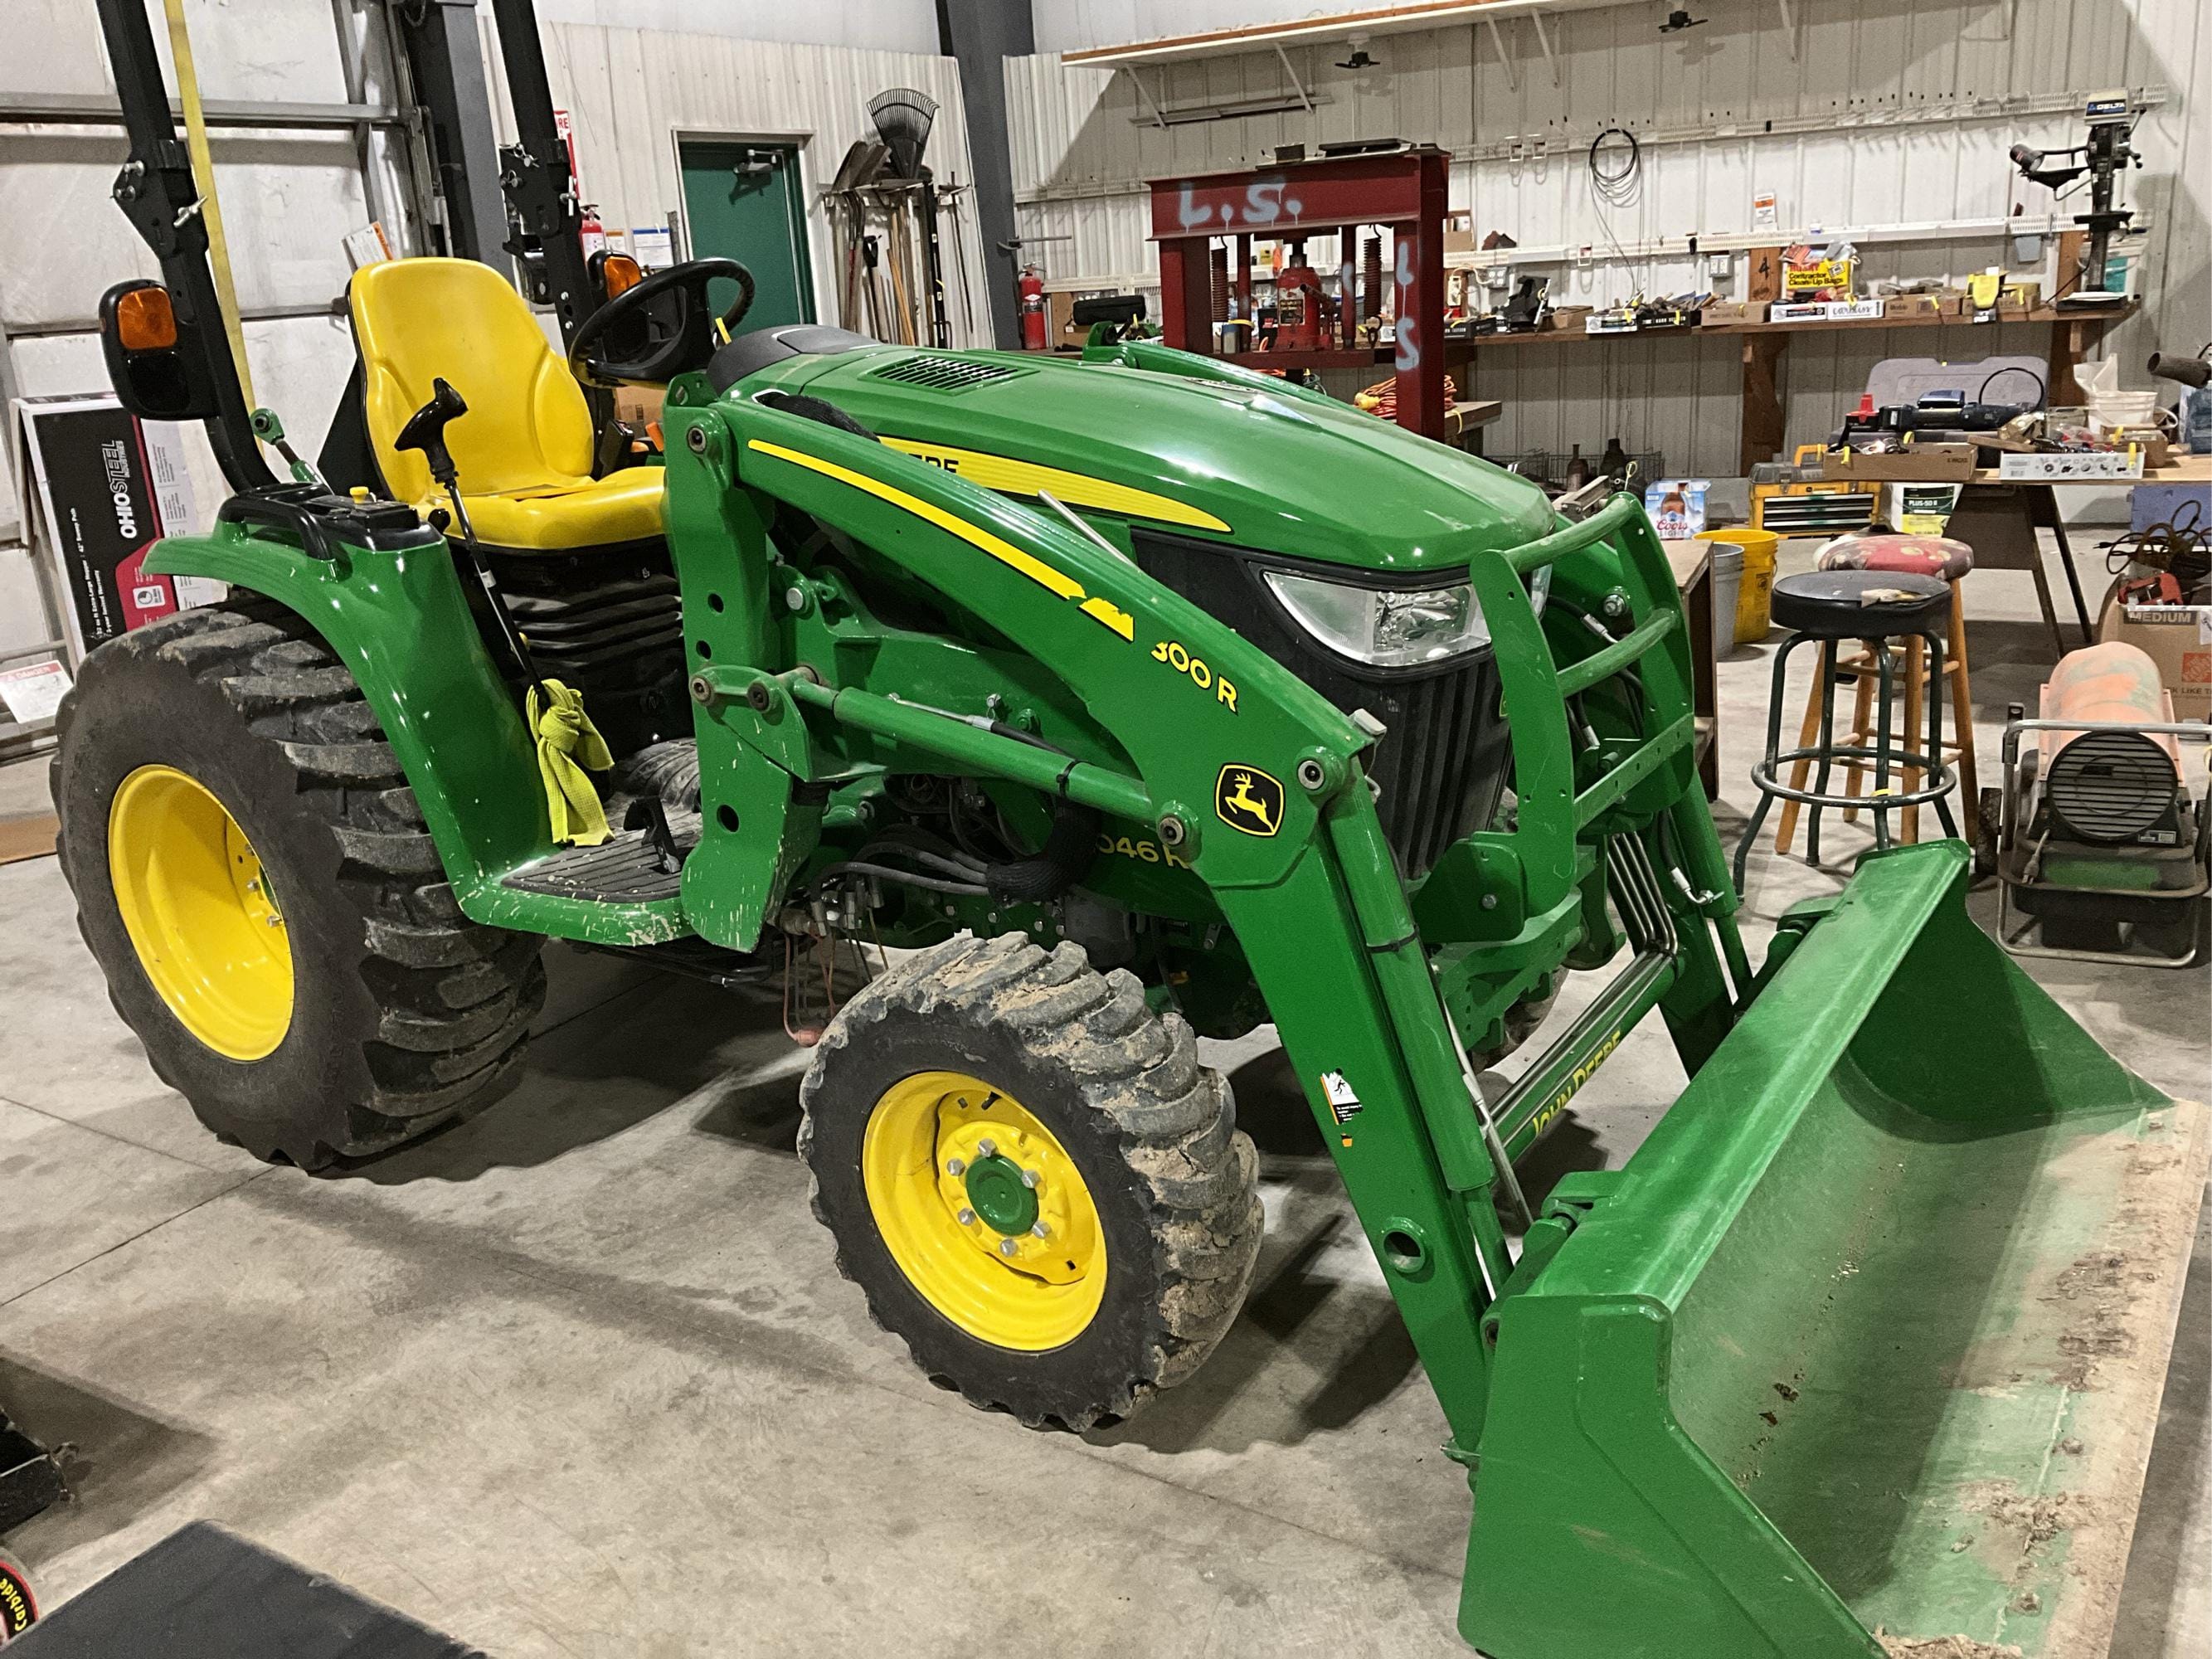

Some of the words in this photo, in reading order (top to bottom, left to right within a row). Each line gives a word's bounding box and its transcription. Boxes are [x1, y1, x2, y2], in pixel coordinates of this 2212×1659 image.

[1758, 256, 1771, 280] 4
[1656, 518, 1688, 531] Coors
[2128, 611, 2191, 623] MEDIUM
[1217, 674, 1237, 715] R
[1095, 833, 1160, 864] 046
